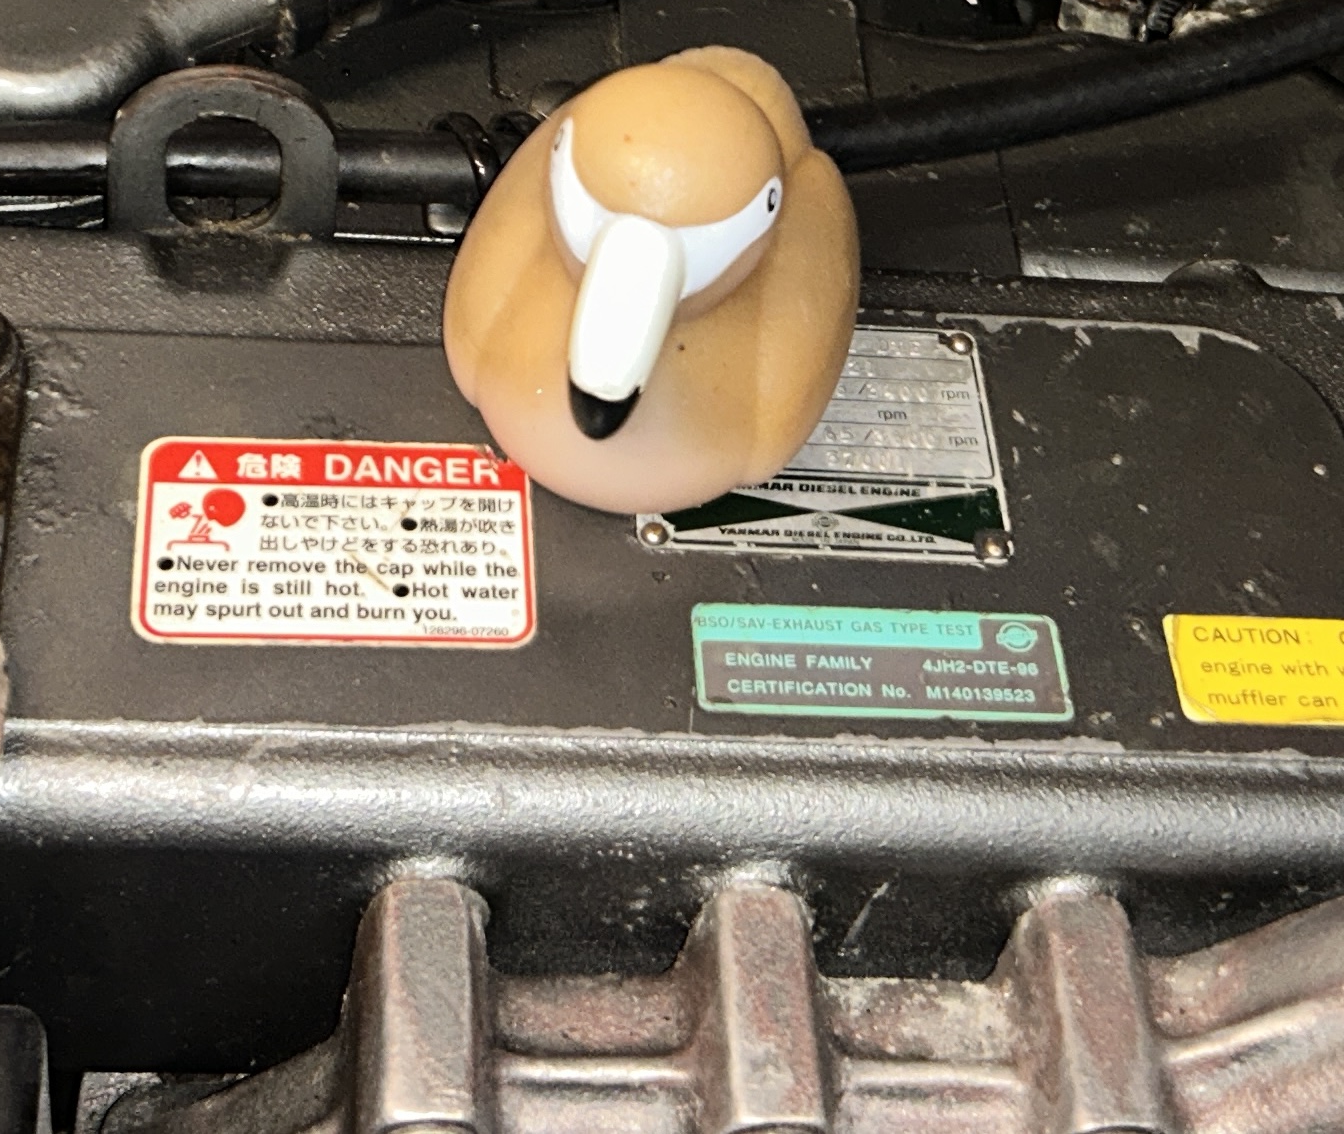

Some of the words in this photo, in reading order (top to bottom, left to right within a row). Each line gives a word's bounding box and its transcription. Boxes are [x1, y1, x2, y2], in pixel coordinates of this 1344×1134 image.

[940, 389, 970, 401] rpm
[877, 409, 907, 421] rpm
[948, 435, 978, 447] rpm
[236, 454, 302, 479] 危険
[324, 453, 500, 485] DANGER
[798, 483, 858, 495] DIESEL
[860, 485, 921, 497] ENGINE
[718, 527, 780, 537] YANMAR
[783, 529, 830, 540] DIESEL
[834, 531, 883, 542] ENGINE
[177, 556, 238, 571] Never
[247, 559, 326, 573] remove
[335, 558, 367, 574] the
[377, 562, 414, 578] cap
[423, 560, 477, 576] while
[485, 562, 518, 577] the
[154, 577, 228, 598] engine
[241, 578, 259, 594] is
[273, 579, 311, 595] still
[325, 580, 366, 597] hot.
[412, 582, 449, 598] Hot
[461, 583, 519, 599] water
[153, 602, 198, 620] may
[206, 602, 262, 620] spurt
[268, 603, 303, 618] out
[310, 603, 349, 619] and
[357, 603, 405, 619] burn
[412, 607, 457, 624] you.
[851, 621, 883, 633] GAS
[891, 622, 929, 635] TYPE
[936, 623, 974, 636] TEST
[725, 652, 797, 667] ENGINE
[806, 654, 873, 671] FAMILY
[1201, 658, 1273, 677] engine
[1282, 660, 1329, 676] with
[727, 679, 872, 697] CERTIFICATION
[881, 683, 912, 699] No.
[1208, 689, 1287, 706] muffler
[1298, 694, 1339, 708] can
